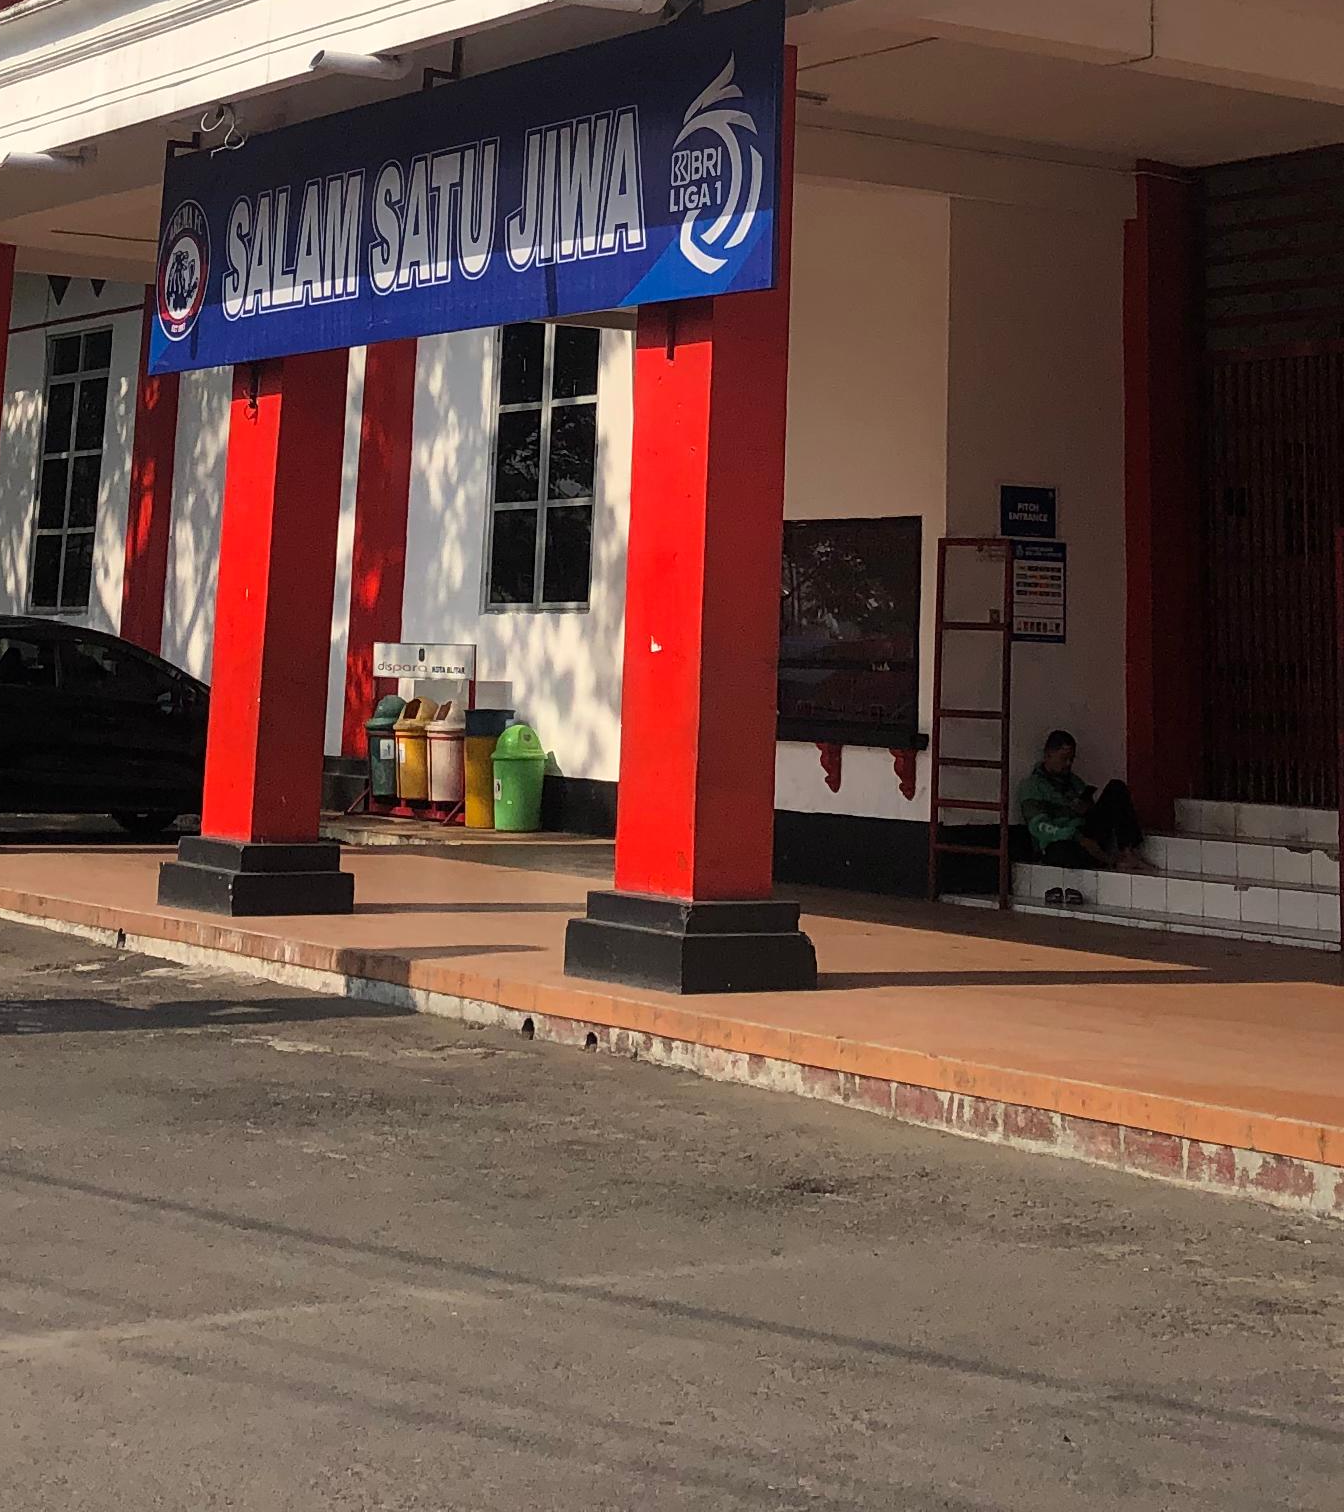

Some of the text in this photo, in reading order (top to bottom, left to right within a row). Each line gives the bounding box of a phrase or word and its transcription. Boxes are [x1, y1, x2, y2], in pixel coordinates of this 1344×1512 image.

[691, 146, 722, 180] BRI
[223, 105, 646, 321] SALAM SATU JIWA
[669, 180, 722, 213] LIGA 1
